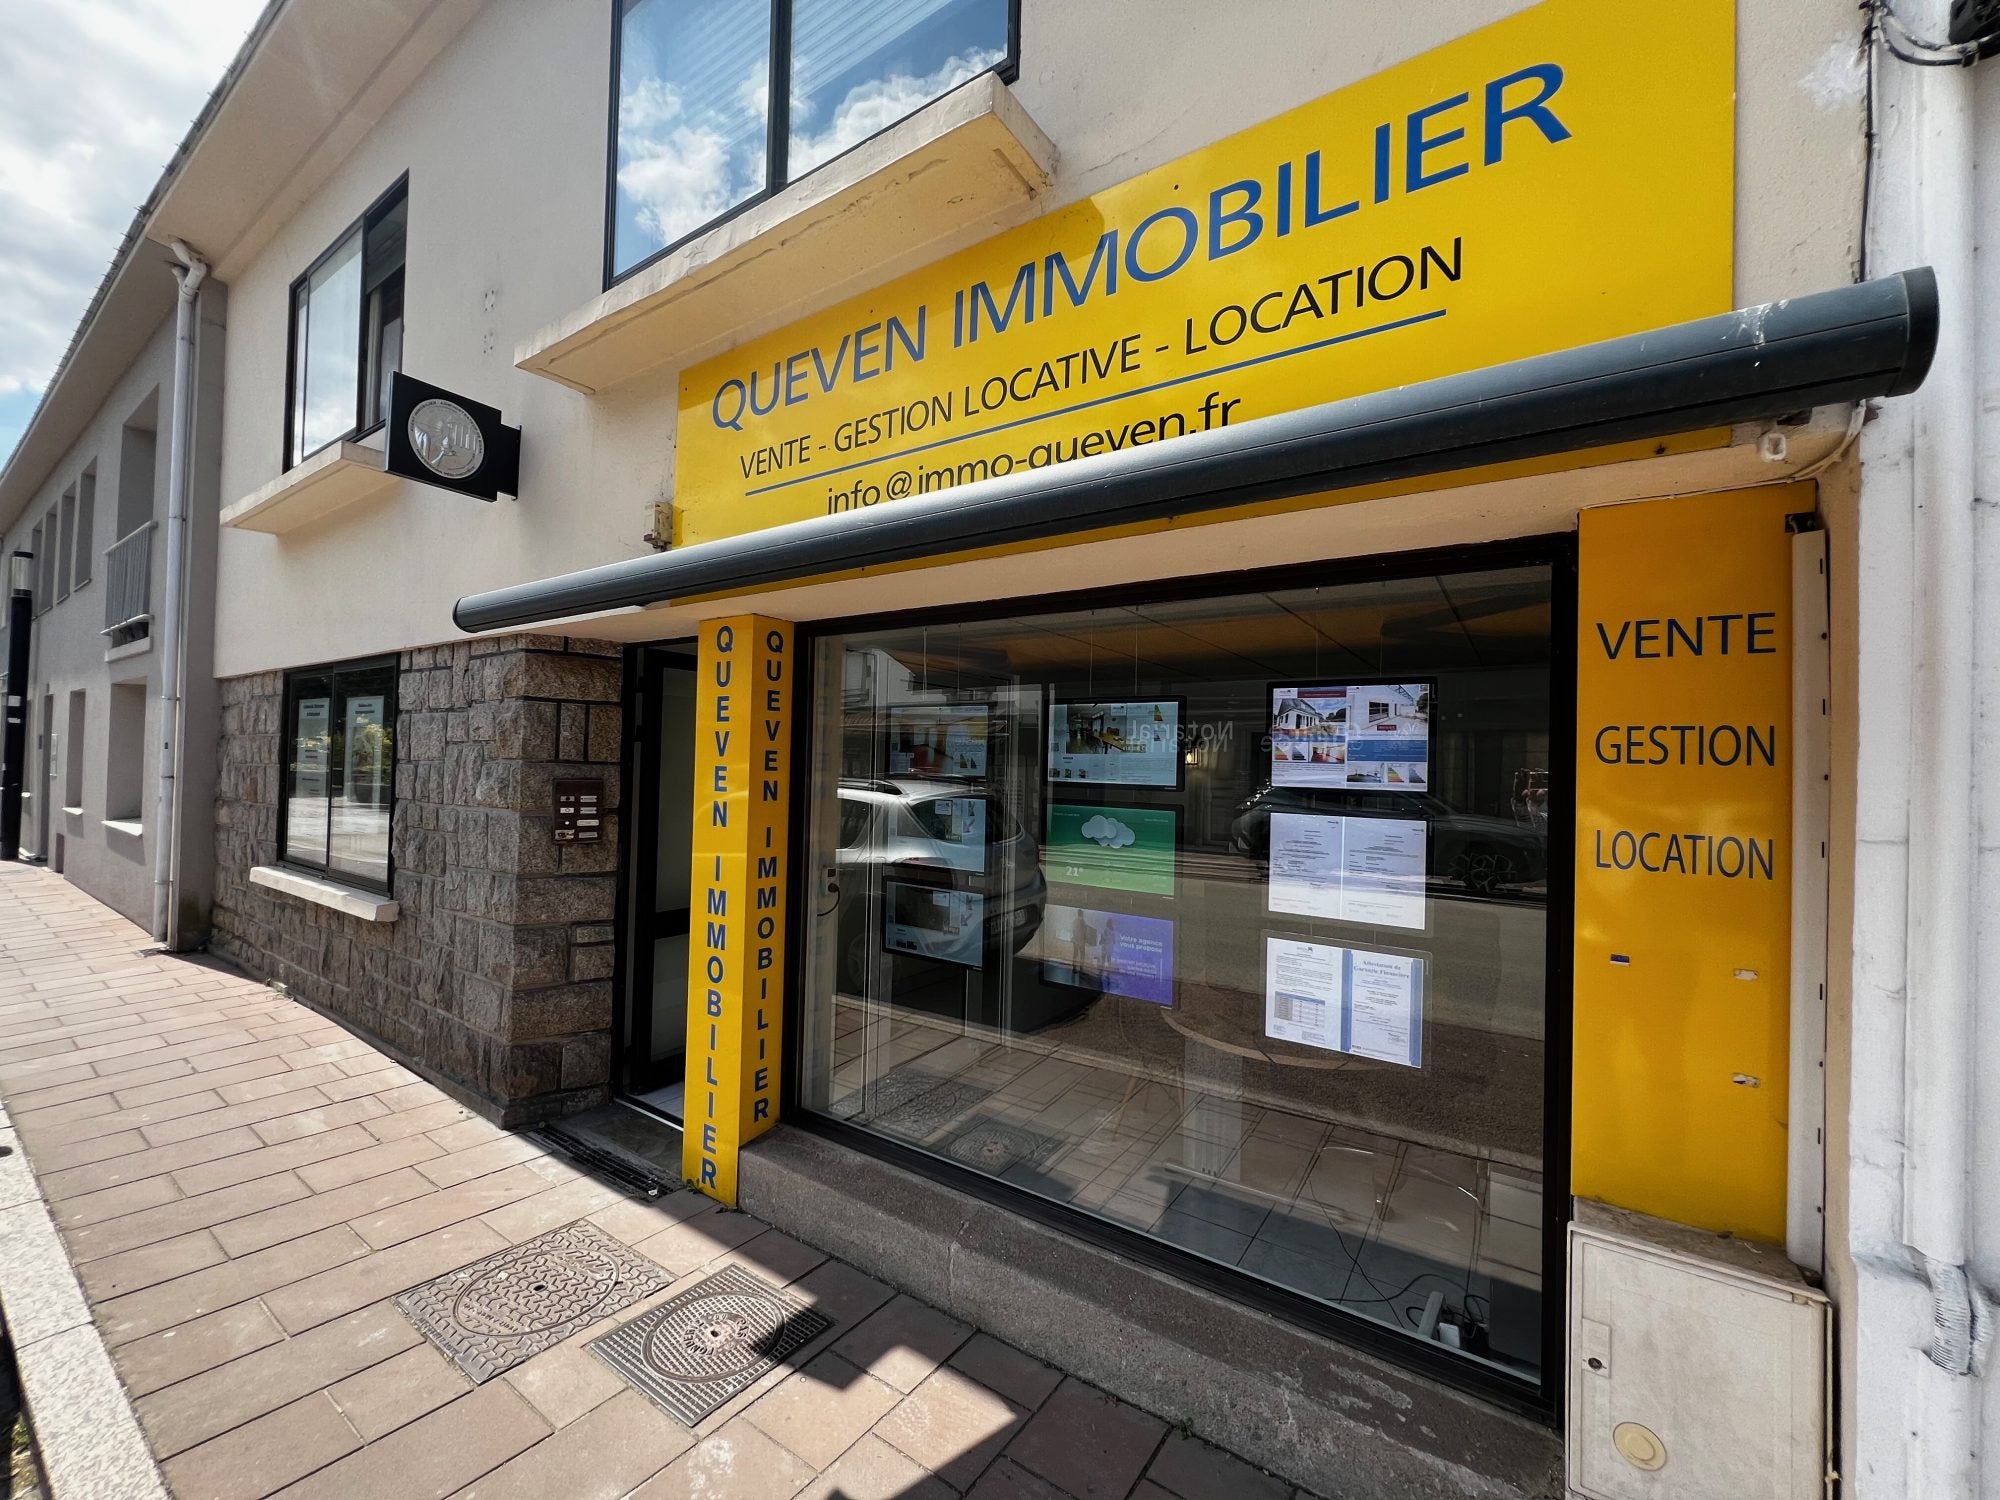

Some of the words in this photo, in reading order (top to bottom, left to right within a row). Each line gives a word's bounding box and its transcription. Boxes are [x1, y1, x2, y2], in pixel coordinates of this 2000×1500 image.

[712, 304, 927, 432] QUEVEN
[953, 63, 1573, 349] IMMOBILIER
[740, 434, 811, 480] VENTE
[834, 391, 953, 453] GESTION
[964, 333, 1141, 418] LOCATIVE
[1185, 237, 1463, 356] LOCATION
[712, 625, 734, 828] QUEVEN
[762, 630, 784, 802] QUEVEN
[1596, 611, 1777, 660] VENTE
[1595, 724, 1776, 767] GESTION
[1595, 829, 1774, 881] LOCATION
[701, 855, 727, 1190] IMMOBILIER
[753, 826, 778, 1123] IMMOBILIER
